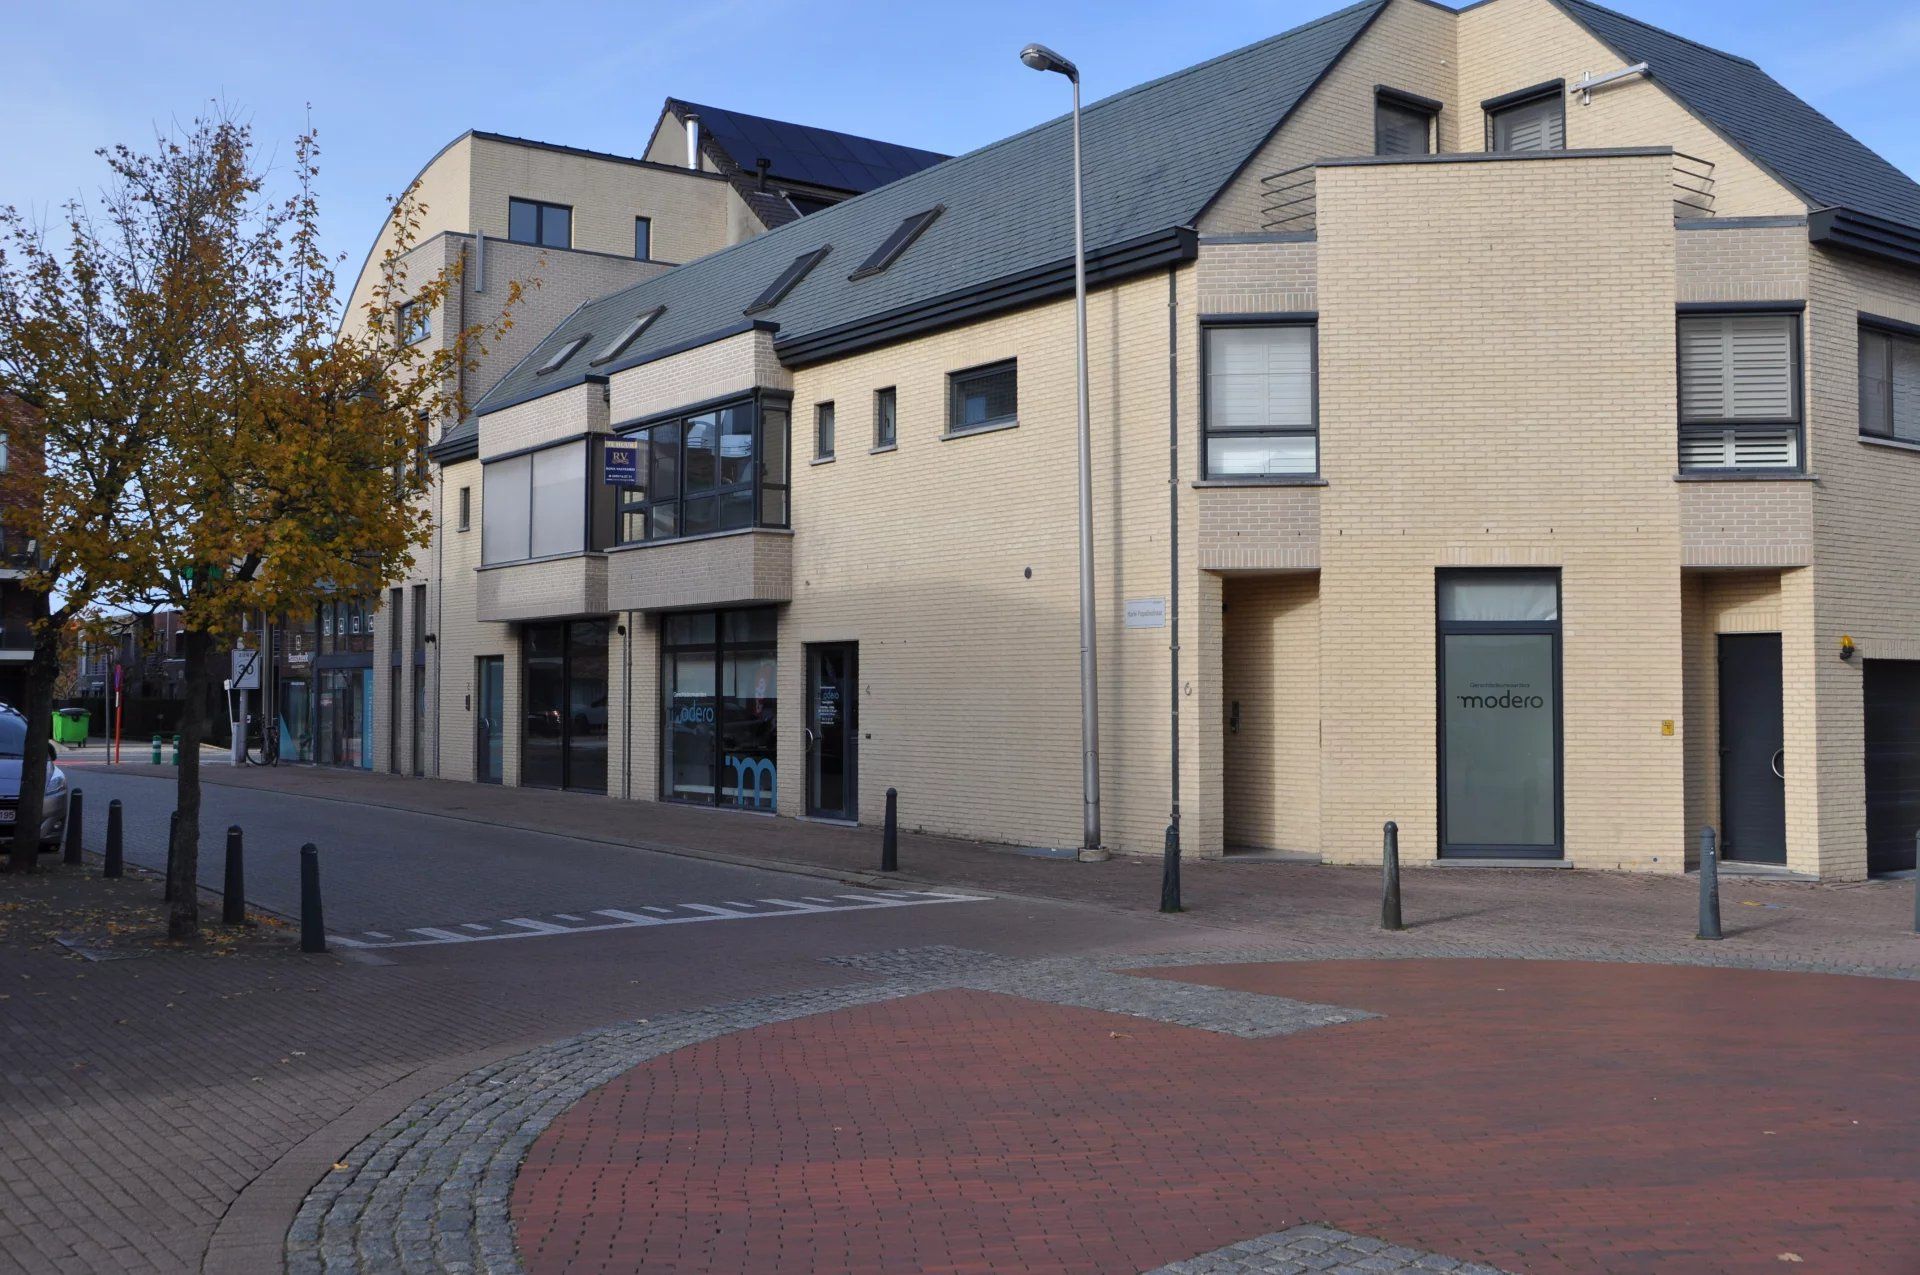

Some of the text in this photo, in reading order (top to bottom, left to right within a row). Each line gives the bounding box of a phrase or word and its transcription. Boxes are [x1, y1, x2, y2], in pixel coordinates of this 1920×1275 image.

[239, 664, 254, 675] 30
[1184, 682, 1192, 696] 6
[1457, 690, 1544, 709] modero
